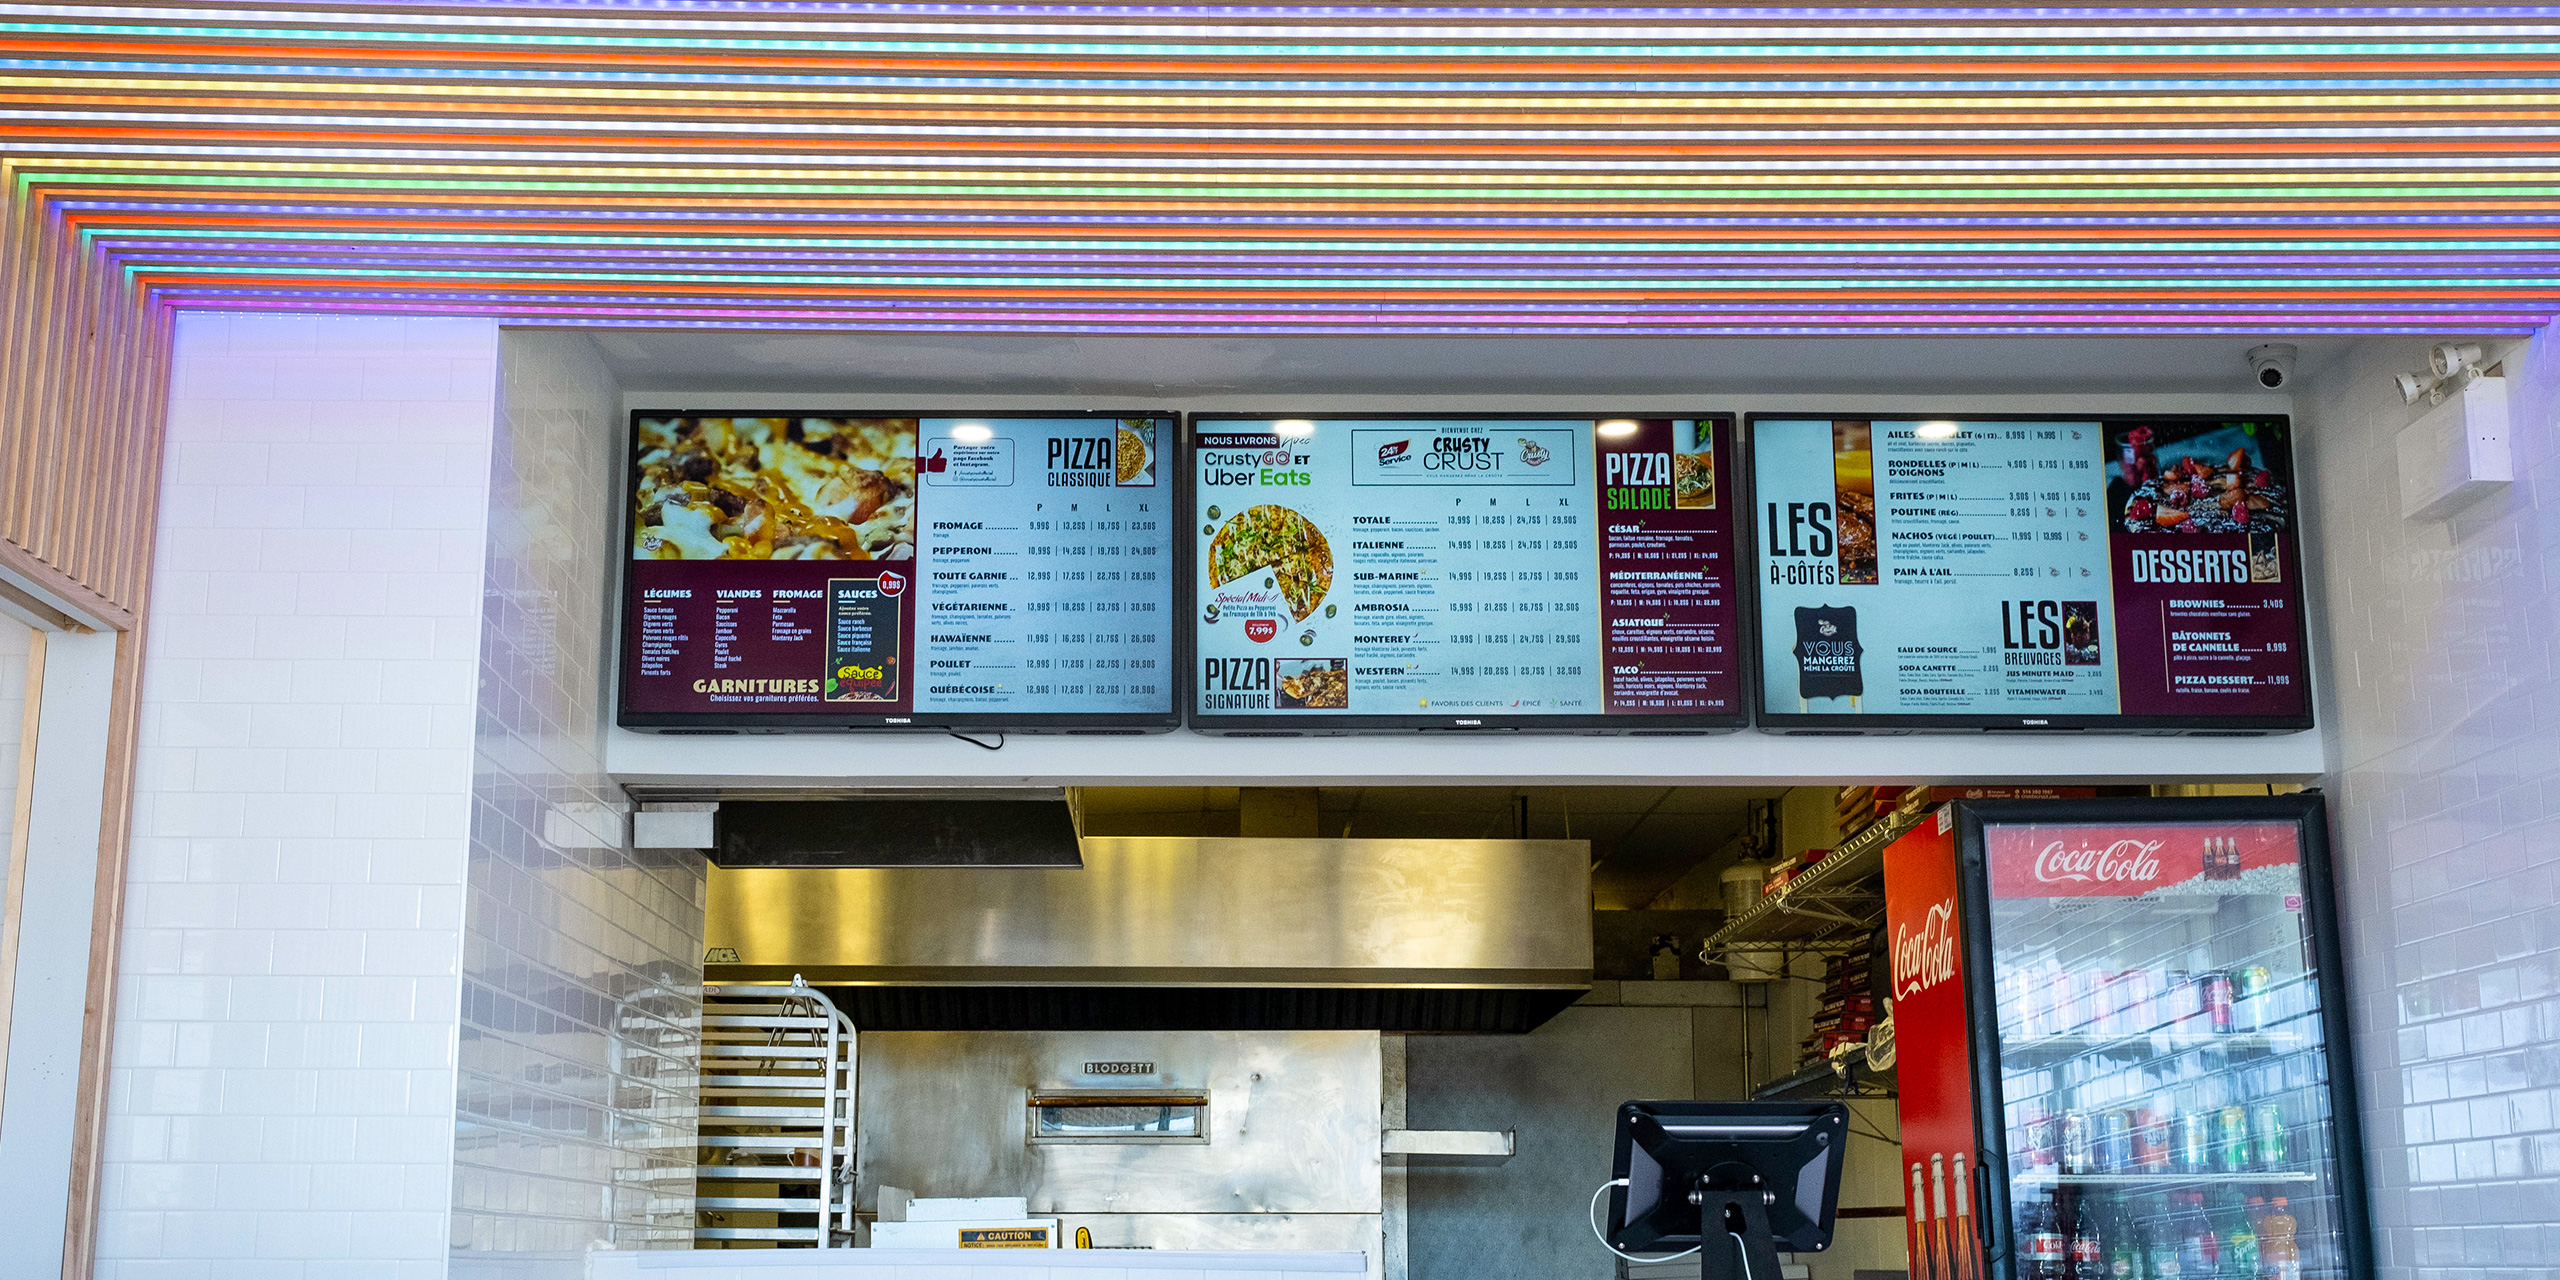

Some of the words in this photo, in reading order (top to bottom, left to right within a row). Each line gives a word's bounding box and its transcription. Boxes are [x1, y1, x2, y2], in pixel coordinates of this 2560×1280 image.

[1888, 431, 1916, 439] AILES
[1205, 437, 1233, 445] NOUS
[1235, 437, 1277, 445] LIVRONS
[1433, 437, 1490, 453] CRUSTY
[1048, 438, 1111, 469] PIZZA
[1295, 455, 1310, 465] ET
[1379, 454, 1412, 466] Service
[1424, 452, 1504, 470] CRUST
[1889, 460, 1946, 468] RONDELLES
[1606, 453, 1670, 486] PIZZA
[1889, 469, 1945, 477] D'OIGNONS
[1048, 473, 1111, 488] CLASSIQUE
[1205, 469, 1255, 486] Uber
[1261, 469, 1311, 486] Eats
[1607, 488, 1671, 510] SALADE
[1037, 504, 1043, 512] P
[1071, 504, 1078, 512] M
[1106, 504, 1111, 512] L
[1139, 504, 1149, 512] XL
[1891, 508, 1936, 516] POUTINE
[933, 522, 983, 530] FROMAGE
[1609, 524, 1640, 533] CÉSAR
[1768, 502, 1833, 557] LES
[1892, 532, 1934, 540] NACHOS
[1353, 541, 1404, 549] ITALIENNE
[933, 547, 992, 555] PEPPERONI
[1894, 568, 1918, 576] PAIN
[1920, 566, 1927, 576] À
[1929, 568, 1952, 576] L'AIL
[2132, 550, 2248, 583] DESSERTS
[933, 572, 966, 580] TOUTE
[969, 572, 1007, 580] GARNIE
[1354, 572, 1419, 581] SUB-MARINE
[1610, 570, 1703, 580] MÉDITERRANÉENNE
[1770, 561, 1835, 586] À-CÔTÉS
[644, 588, 692, 598] LÉGUMES
[717, 590, 762, 598] VIANDES
[773, 590, 823, 598] FROMAGE
[838, 590, 878, 598] SAUCES
[1246, 591, 1268, 602] Midi
[932, 601, 1008, 611] VÉGÉTARIENNE
[1354, 604, 1410, 612] AMBROSIA
[2170, 600, 2225, 608] BROWNIES
[1612, 619, 1664, 627] ASIATIQUE
[2001, 600, 2060, 650] LES
[931, 633, 992, 643] HAWAÏENNE
[1354, 636, 1411, 644] MONTEREY
[2172, 631, 2231, 640] BÂTONNETS
[1803, 641, 1855, 656] VOUS
[2173, 643, 2187, 651] DE
[2189, 643, 2240, 651] CANNELLE
[1804, 656, 1855, 665] MANGEREZ
[2005, 652, 2061, 666] BREUVAGES
[1206, 658, 1270, 690] PIZZA
[1355, 668, 1405, 676] WESTERN
[1613, 666, 1638, 674] TACO
[693, 679, 819, 694] GARNITURES
[930, 684, 995, 694] QUÉBÉCOISE
[710, 694, 741, 702] Choisissez
[755, 694, 787, 703] garnitures
[1206, 694, 1270, 709] SIGNATURE
[1523, 699, 1541, 707] ÉPICÉ
[1560, 699, 1582, 707] SANTÉ
[2034, 839, 2166, 883] Coca-Cola
[1894, 897, 1955, 1001] Coca-Cola
[1087, 1063, 1152, 1073] BLODGETT
[988, 1232, 1031, 1240] CAUTION
